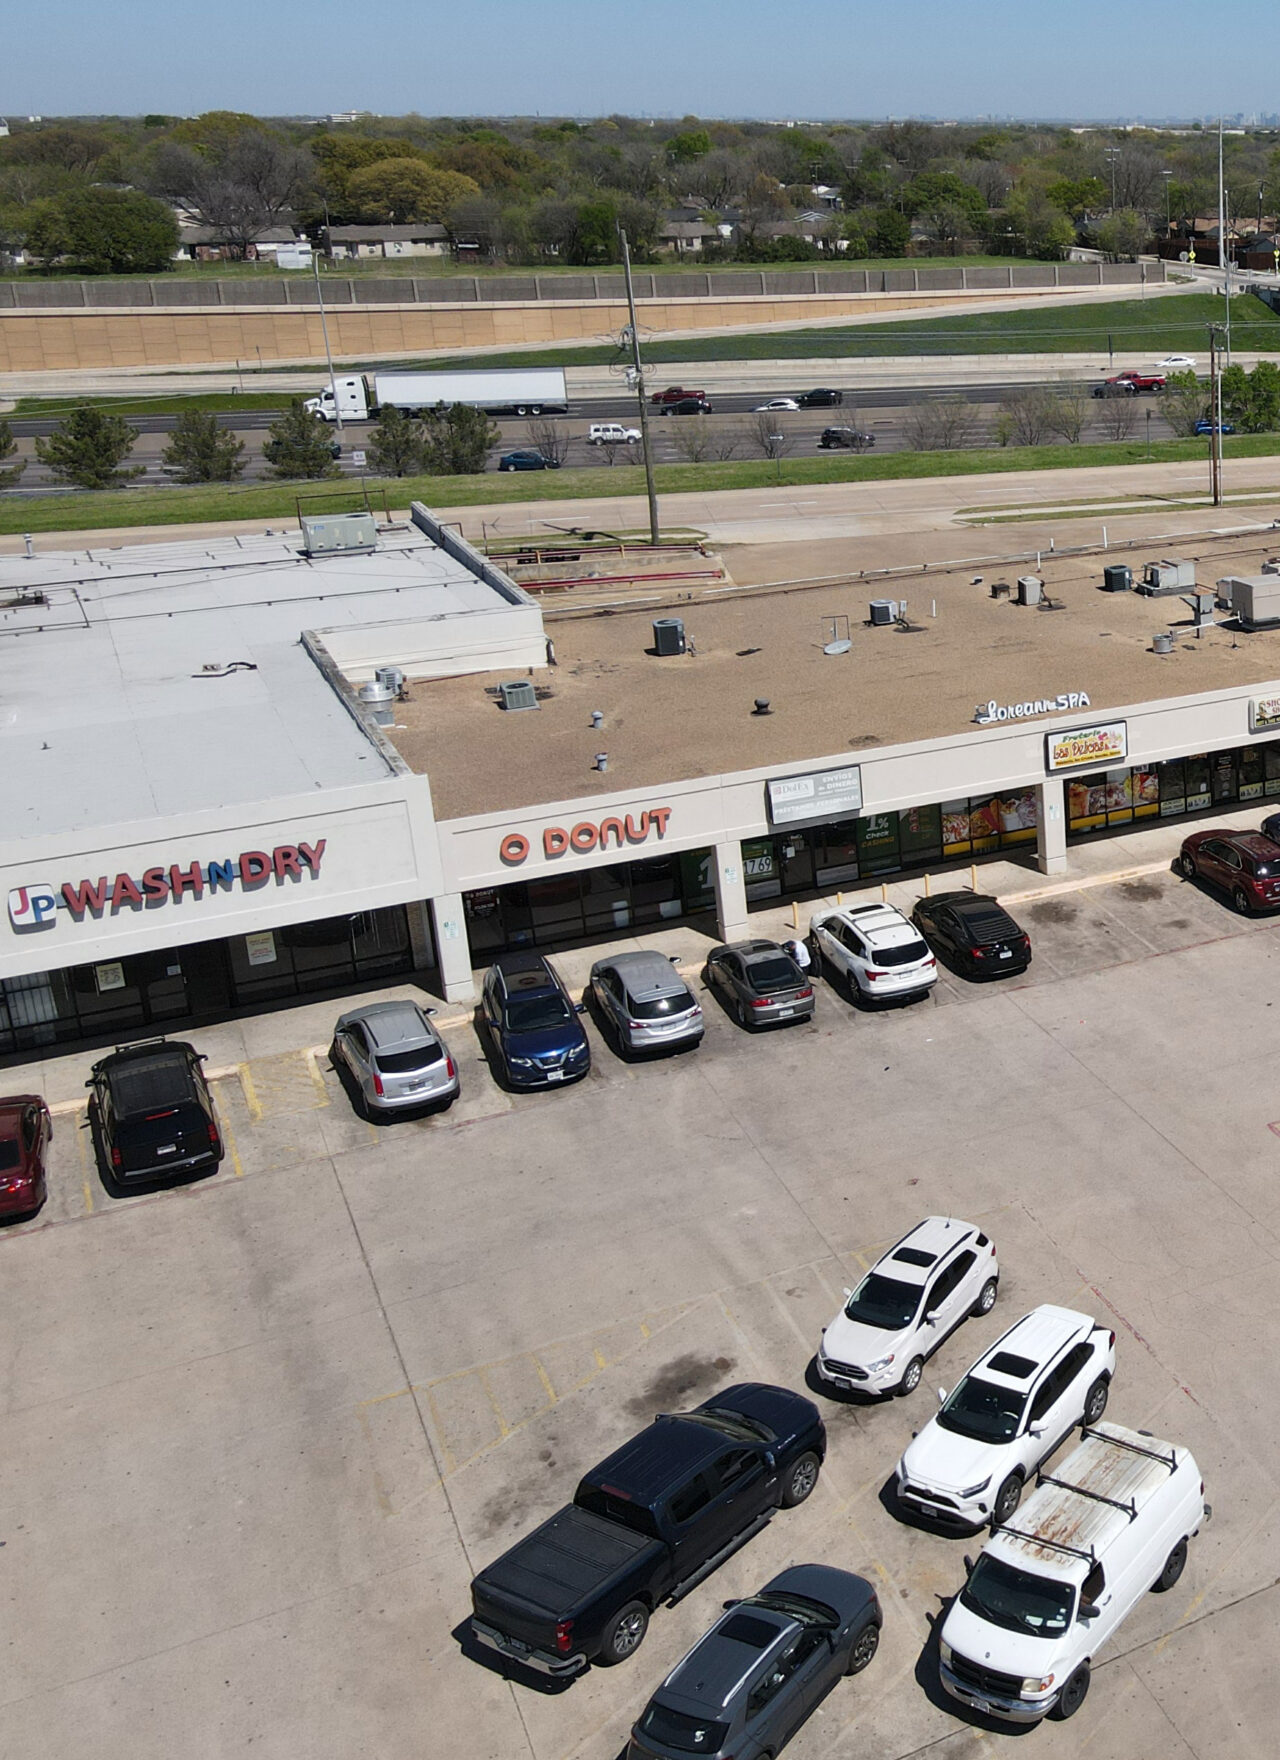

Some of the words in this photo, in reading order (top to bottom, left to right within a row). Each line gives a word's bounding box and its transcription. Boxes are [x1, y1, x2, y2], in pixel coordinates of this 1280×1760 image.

[1057, 691, 1090, 710] SPA
[500, 833, 530, 861] O
[544, 807, 672, 854] DONUT
